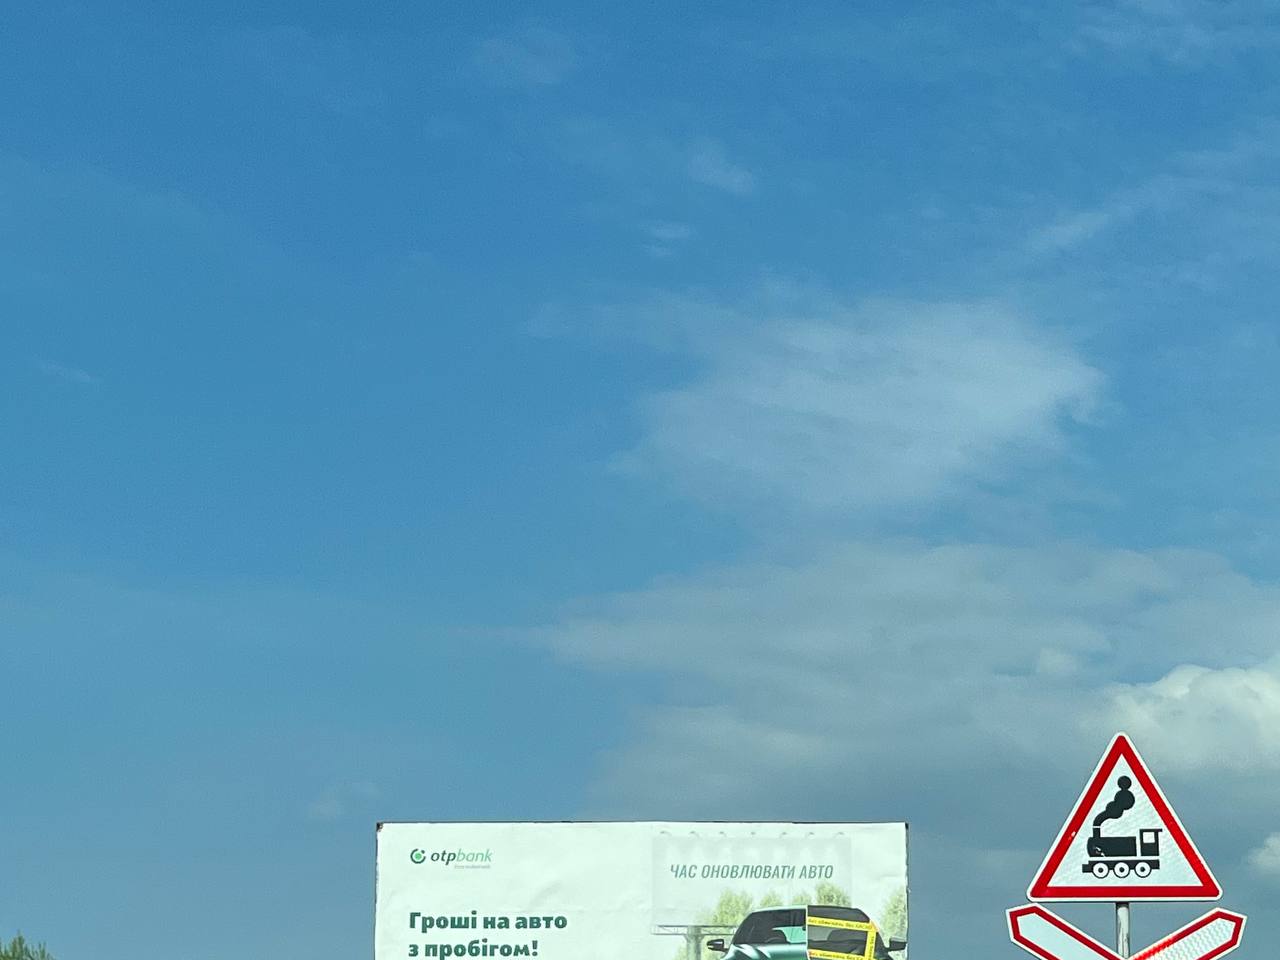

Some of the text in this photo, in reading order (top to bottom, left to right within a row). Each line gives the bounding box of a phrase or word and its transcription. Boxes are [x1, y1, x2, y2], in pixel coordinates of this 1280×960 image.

[430, 848, 493, 865] otpbank
[670, 864, 834, 879] ЧАС ОНОВЛЮВАТИ АВТО
[409, 910, 568, 933] Гроші на авто
[408, 938, 539, 960] з пробігом!
